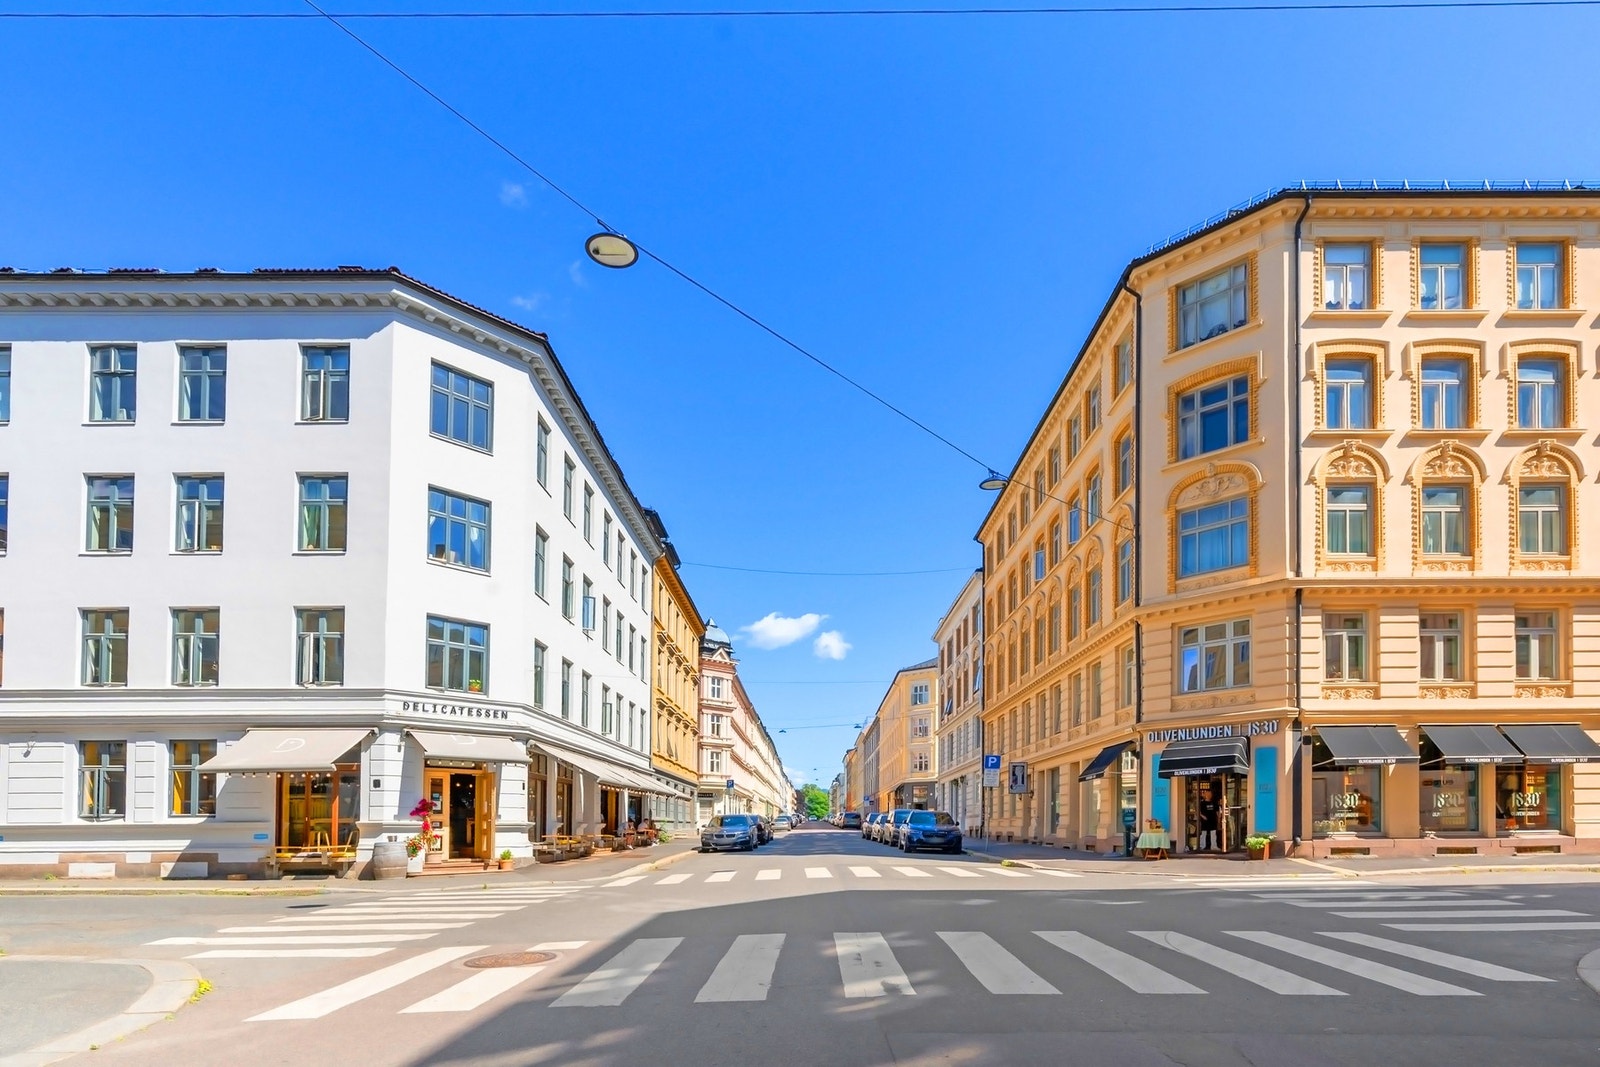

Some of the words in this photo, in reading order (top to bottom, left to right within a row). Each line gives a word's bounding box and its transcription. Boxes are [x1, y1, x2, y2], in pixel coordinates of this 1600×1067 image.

[402, 701, 508, 720] DELICATESSEN
[1147, 725, 1232, 743] OLIVENLUNDEN
[1247, 719, 1280, 737] 1830
[988, 757, 997, 768] P
